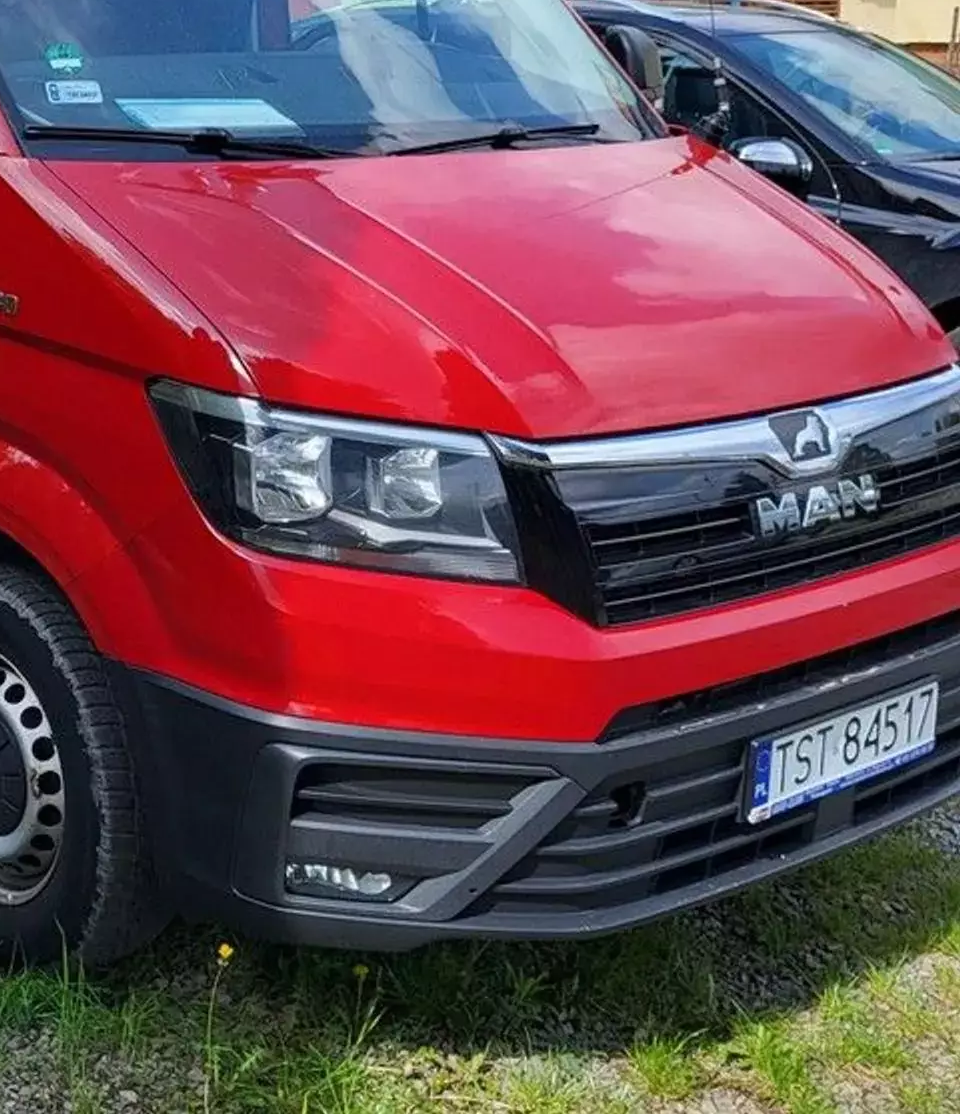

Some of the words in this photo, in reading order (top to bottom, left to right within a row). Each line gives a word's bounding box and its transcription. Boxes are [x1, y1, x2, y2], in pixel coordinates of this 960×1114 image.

[756, 474, 881, 536] MAN
[776, 725, 834, 793] TST
[842, 688, 934, 765] 84517
